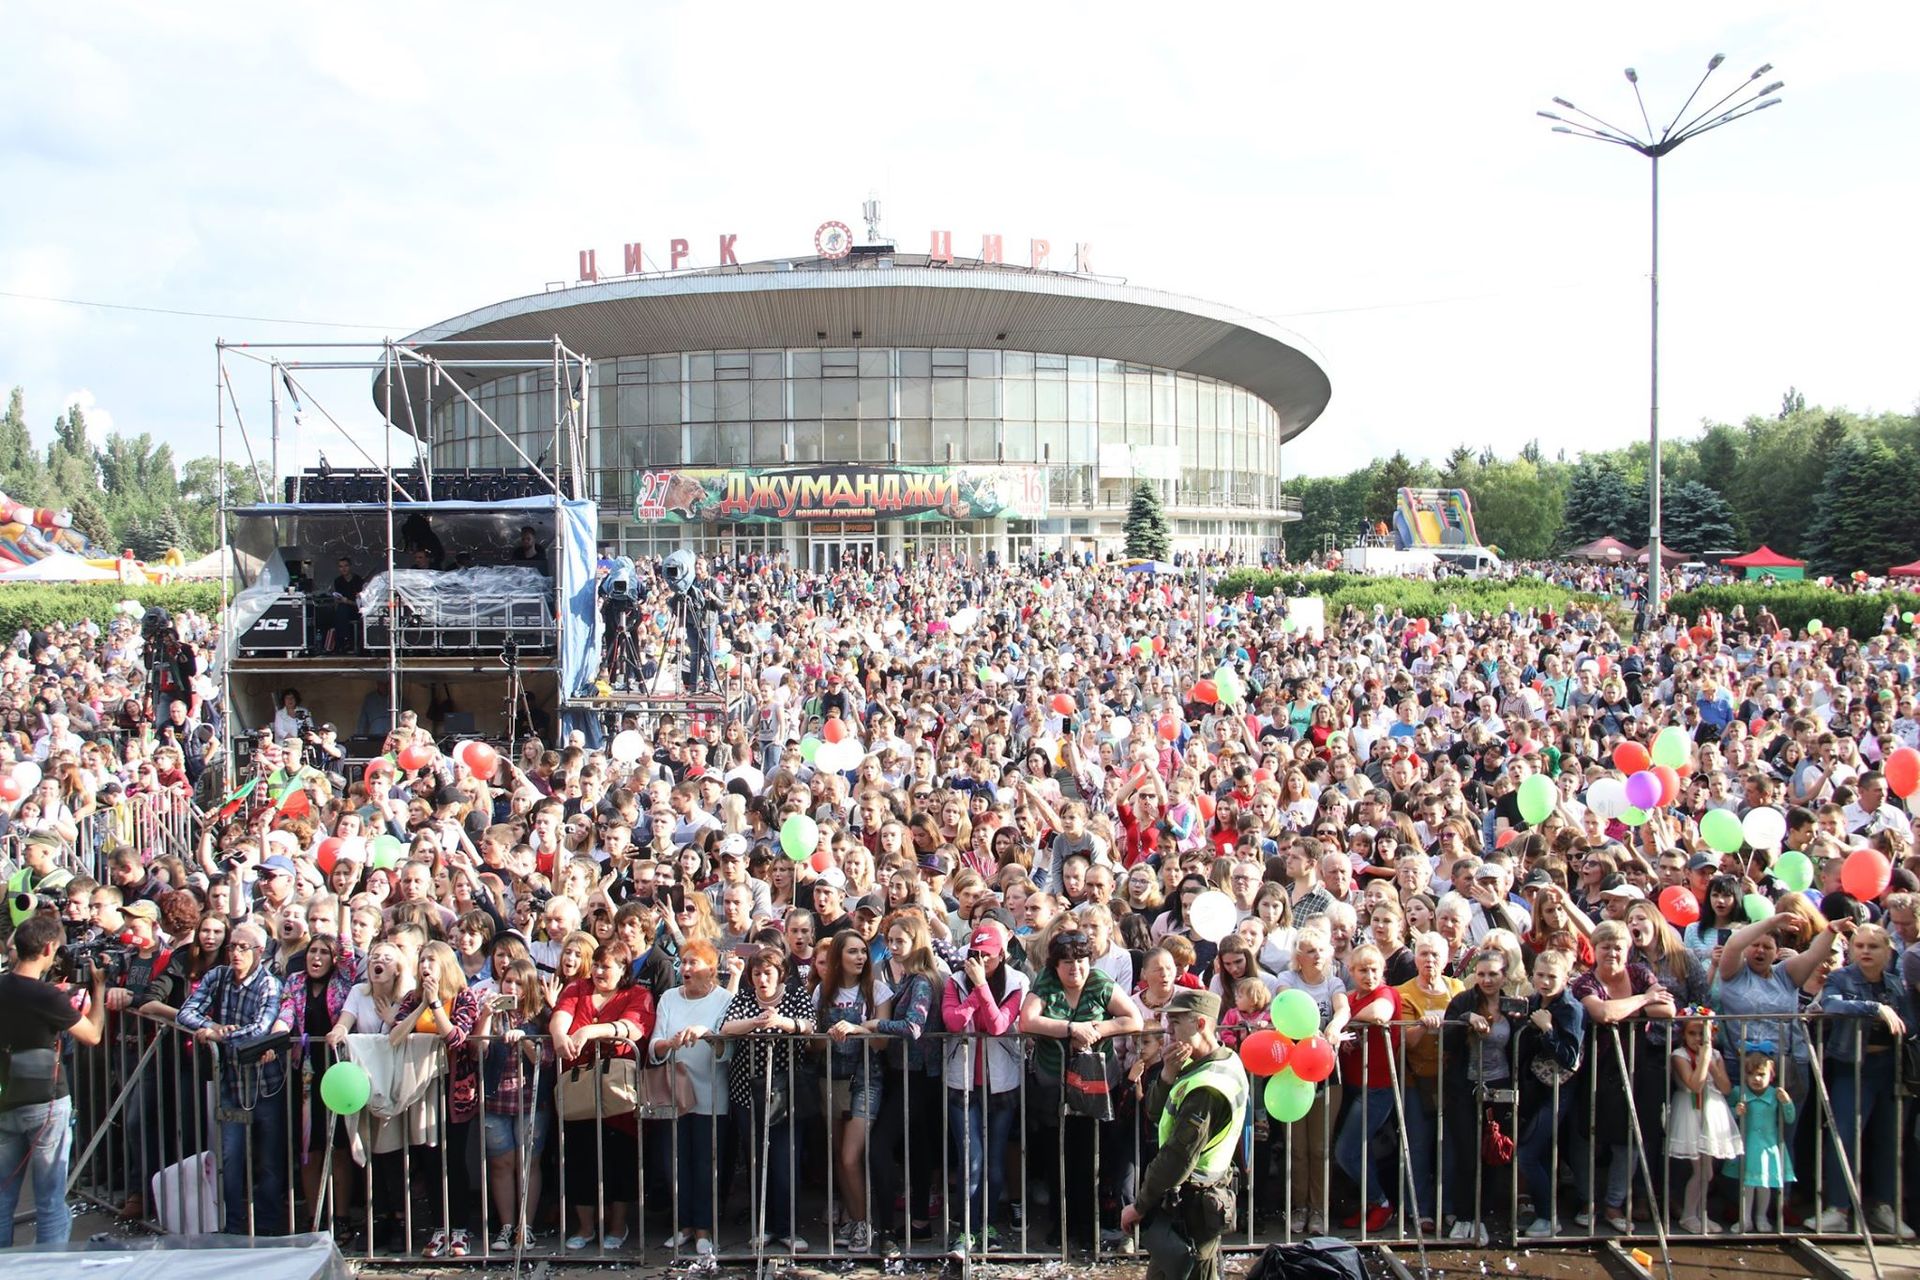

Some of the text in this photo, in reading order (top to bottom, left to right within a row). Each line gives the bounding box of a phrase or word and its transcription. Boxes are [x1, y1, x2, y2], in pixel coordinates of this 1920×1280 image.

[579, 233, 738, 283] ЦИРК
[931, 230, 1092, 273] ЦИРК
[642, 473, 671, 507] 27
[1020, 473, 1041, 504] 16
